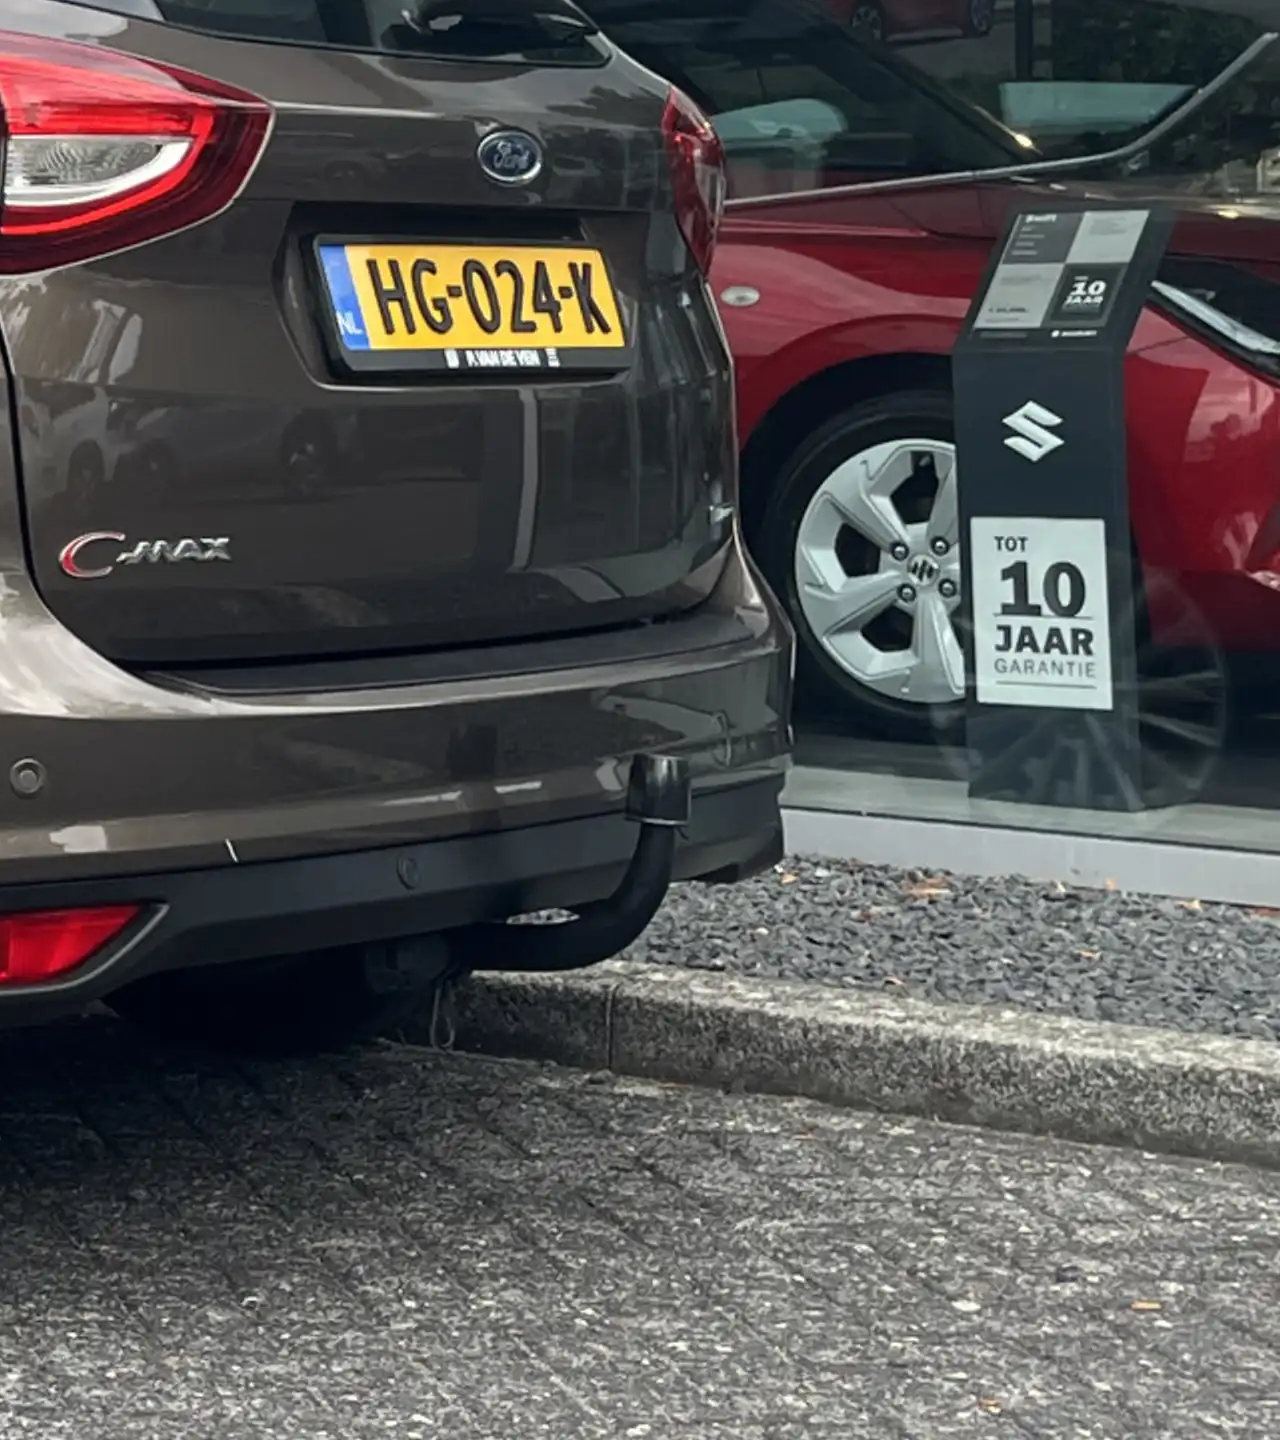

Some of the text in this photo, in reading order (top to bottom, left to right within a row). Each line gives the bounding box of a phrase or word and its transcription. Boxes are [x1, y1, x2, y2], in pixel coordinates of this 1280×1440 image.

[366, 257, 612, 336] HG-024-K
[1070, 280, 1107, 296] 10
[336, 311, 362, 336] NL
[994, 535, 1029, 553] TOT
[999, 560, 1087, 618] 10
[994, 624, 1095, 657] JAAR
[993, 657, 1097, 679] GARANTIE
